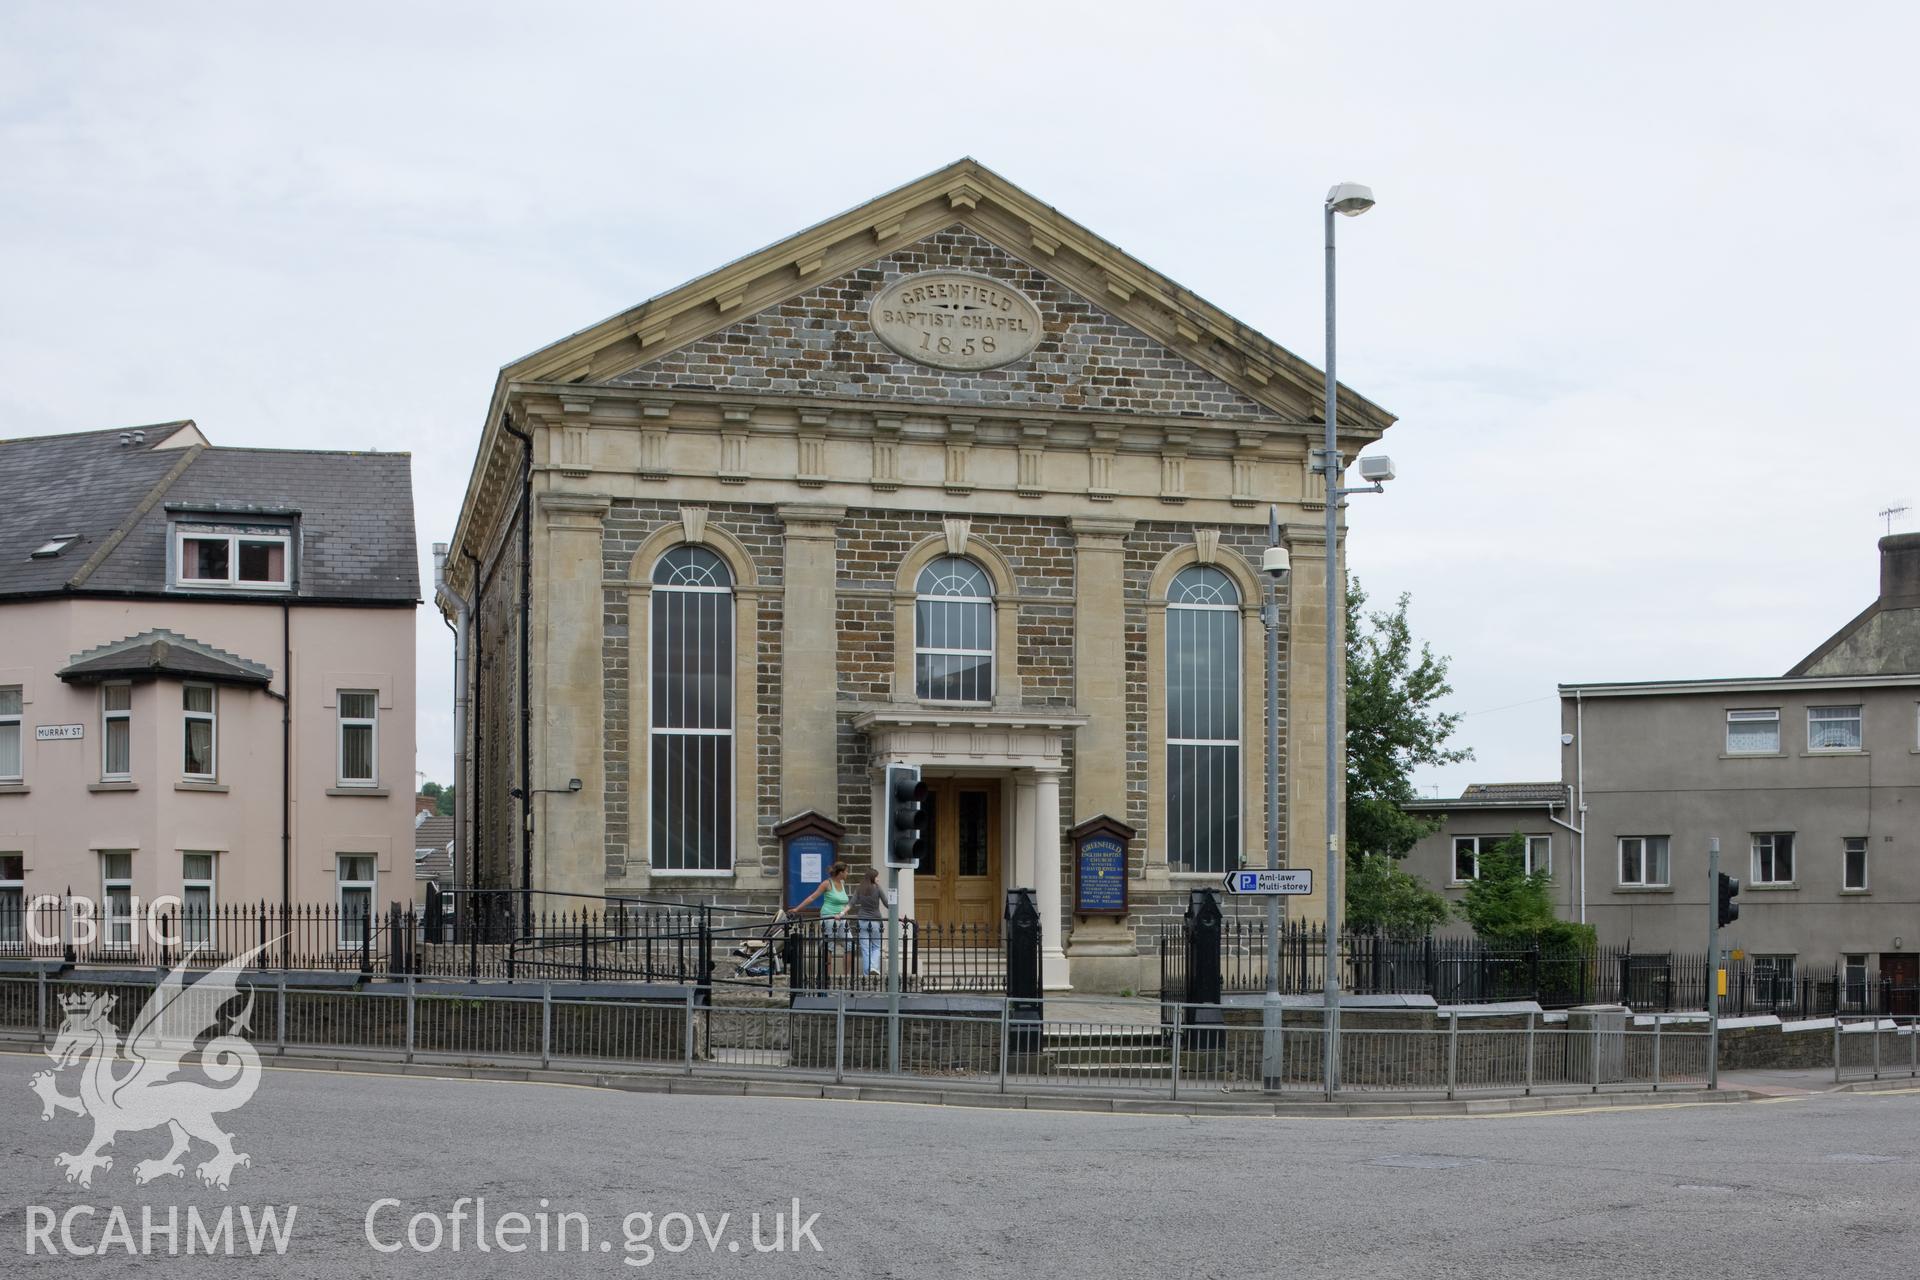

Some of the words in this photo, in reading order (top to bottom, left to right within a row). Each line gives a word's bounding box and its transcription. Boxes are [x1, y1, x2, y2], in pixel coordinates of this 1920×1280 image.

[901, 284, 1012, 311] GREENFIELD
[883, 310, 954, 328] BAPTIST
[961, 315, 1028, 333] CHAPEL
[919, 331, 996, 356] 1858
[38, 728, 69, 737] MURRAY
[72, 728, 81, 736] ST
[1258, 883, 1308, 891] Multi-storey
